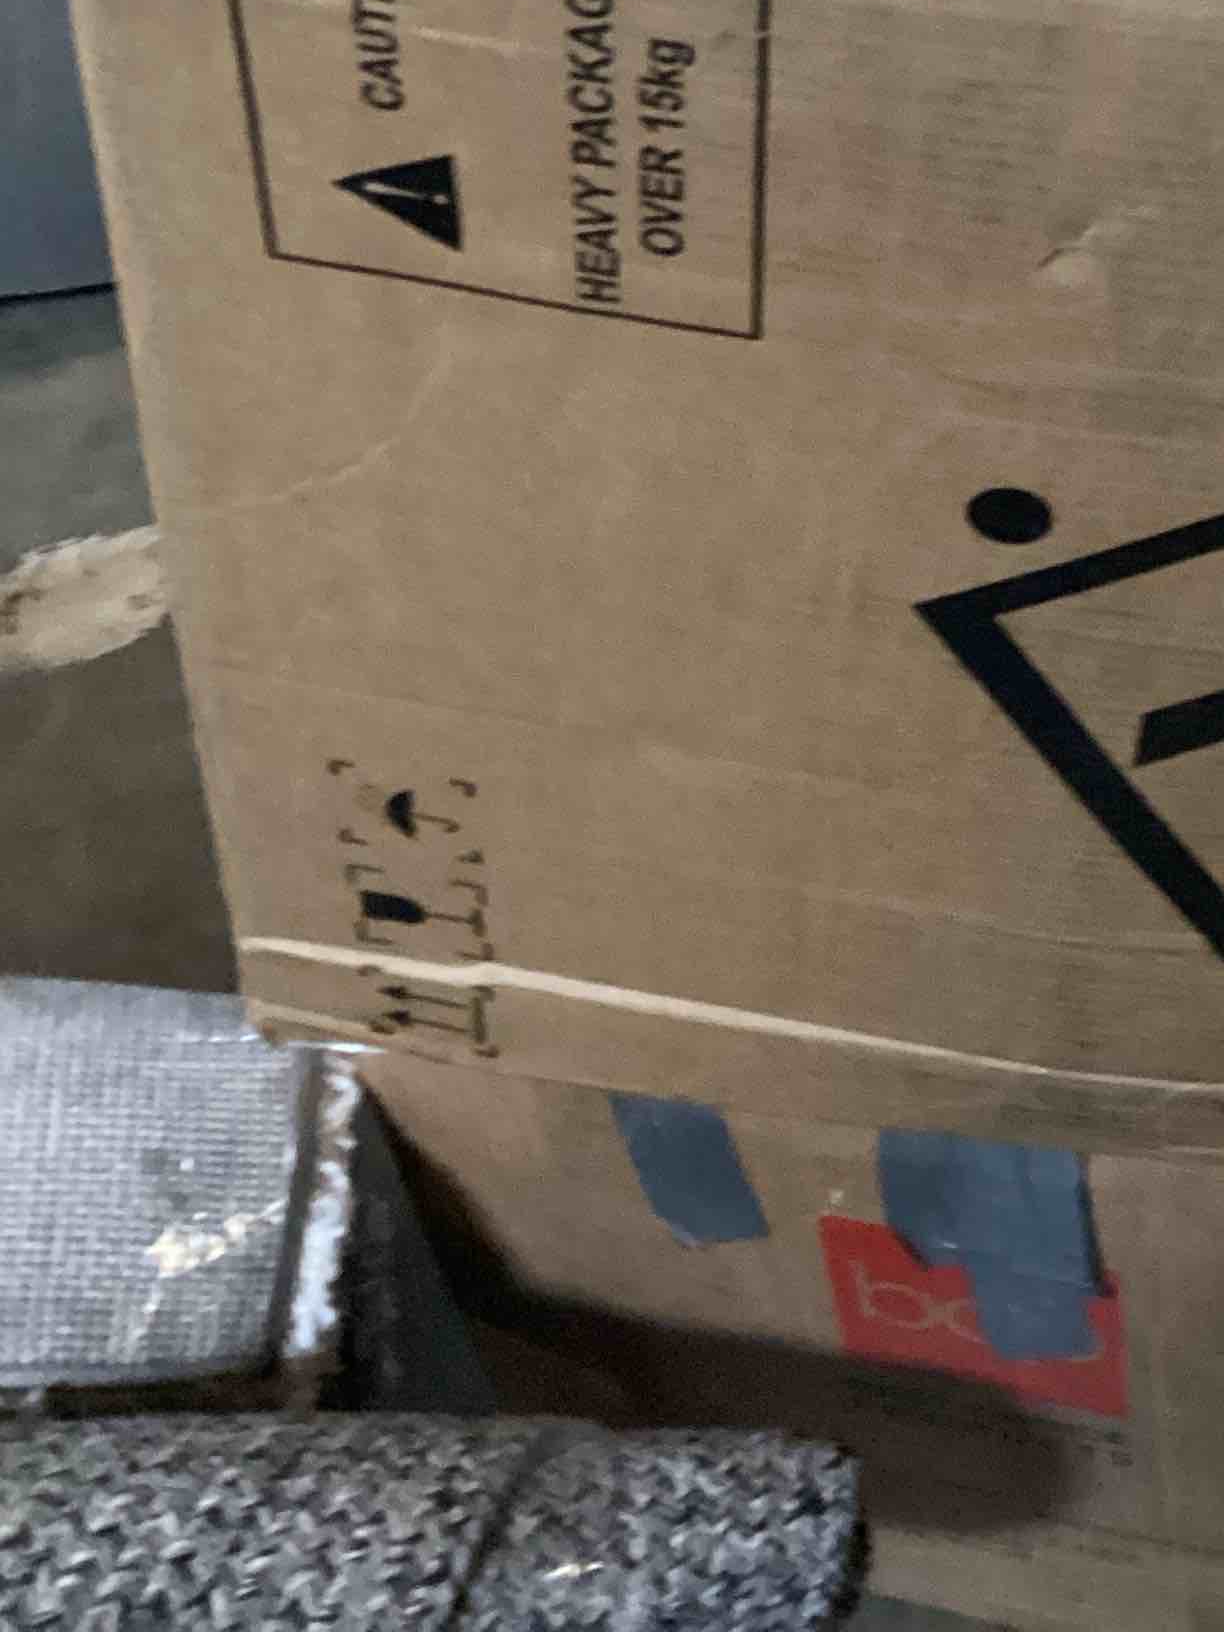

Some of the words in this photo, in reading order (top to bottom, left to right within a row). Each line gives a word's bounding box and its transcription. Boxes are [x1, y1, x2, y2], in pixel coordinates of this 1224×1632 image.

[636, 38, 695, 133] 15kg
[570, 177, 623, 305] HEAVY
[639, 146, 687, 258] OVER
